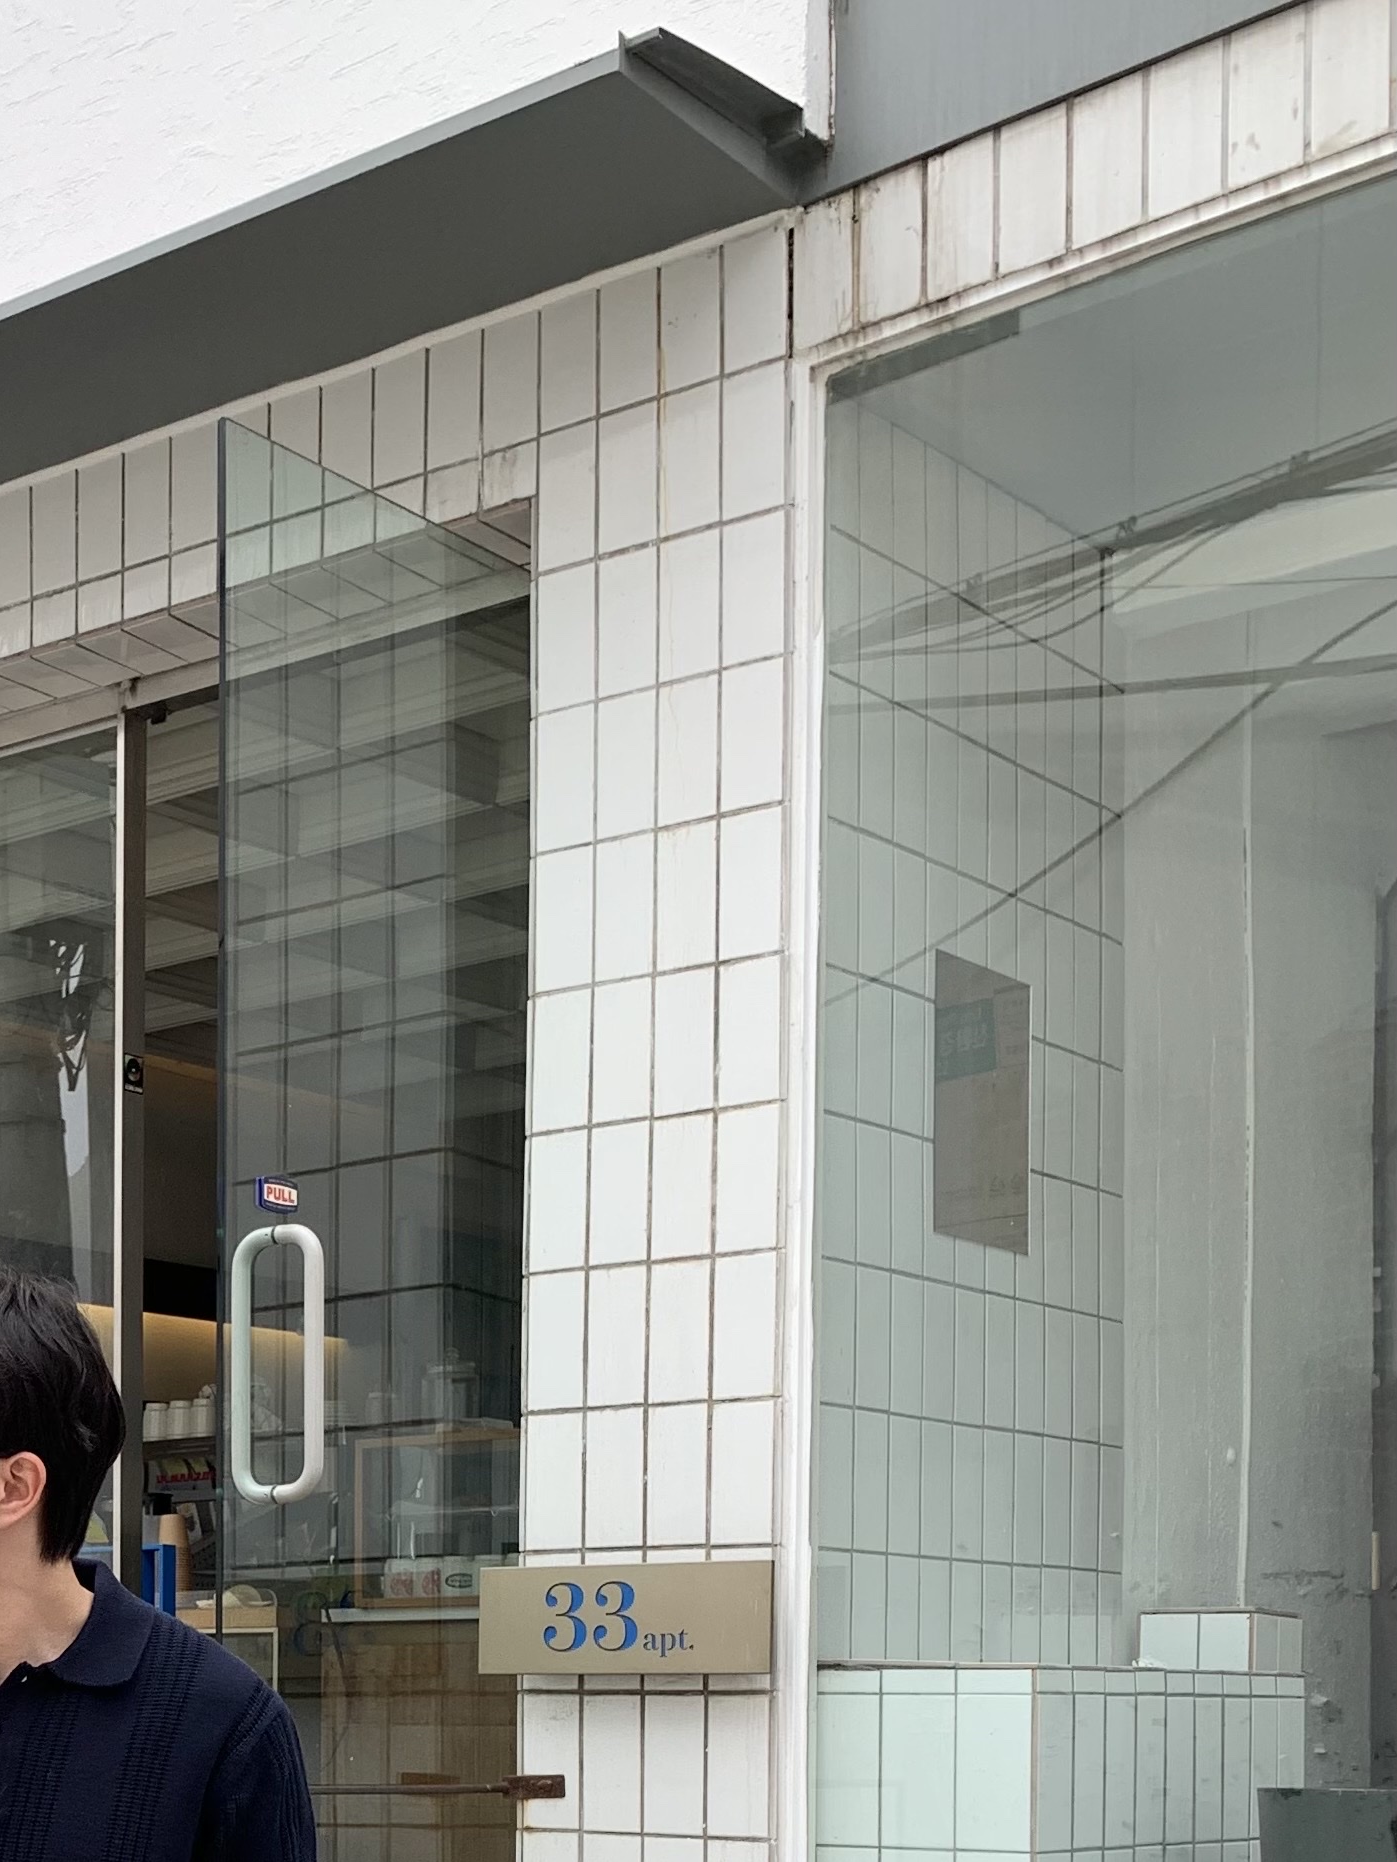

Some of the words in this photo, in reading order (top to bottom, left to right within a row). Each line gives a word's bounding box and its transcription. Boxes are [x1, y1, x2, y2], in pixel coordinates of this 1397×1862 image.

[266, 1186, 295, 1204] PULL
[543, 1580, 639, 1652] 33
[642, 1628, 695, 1658] apt.
